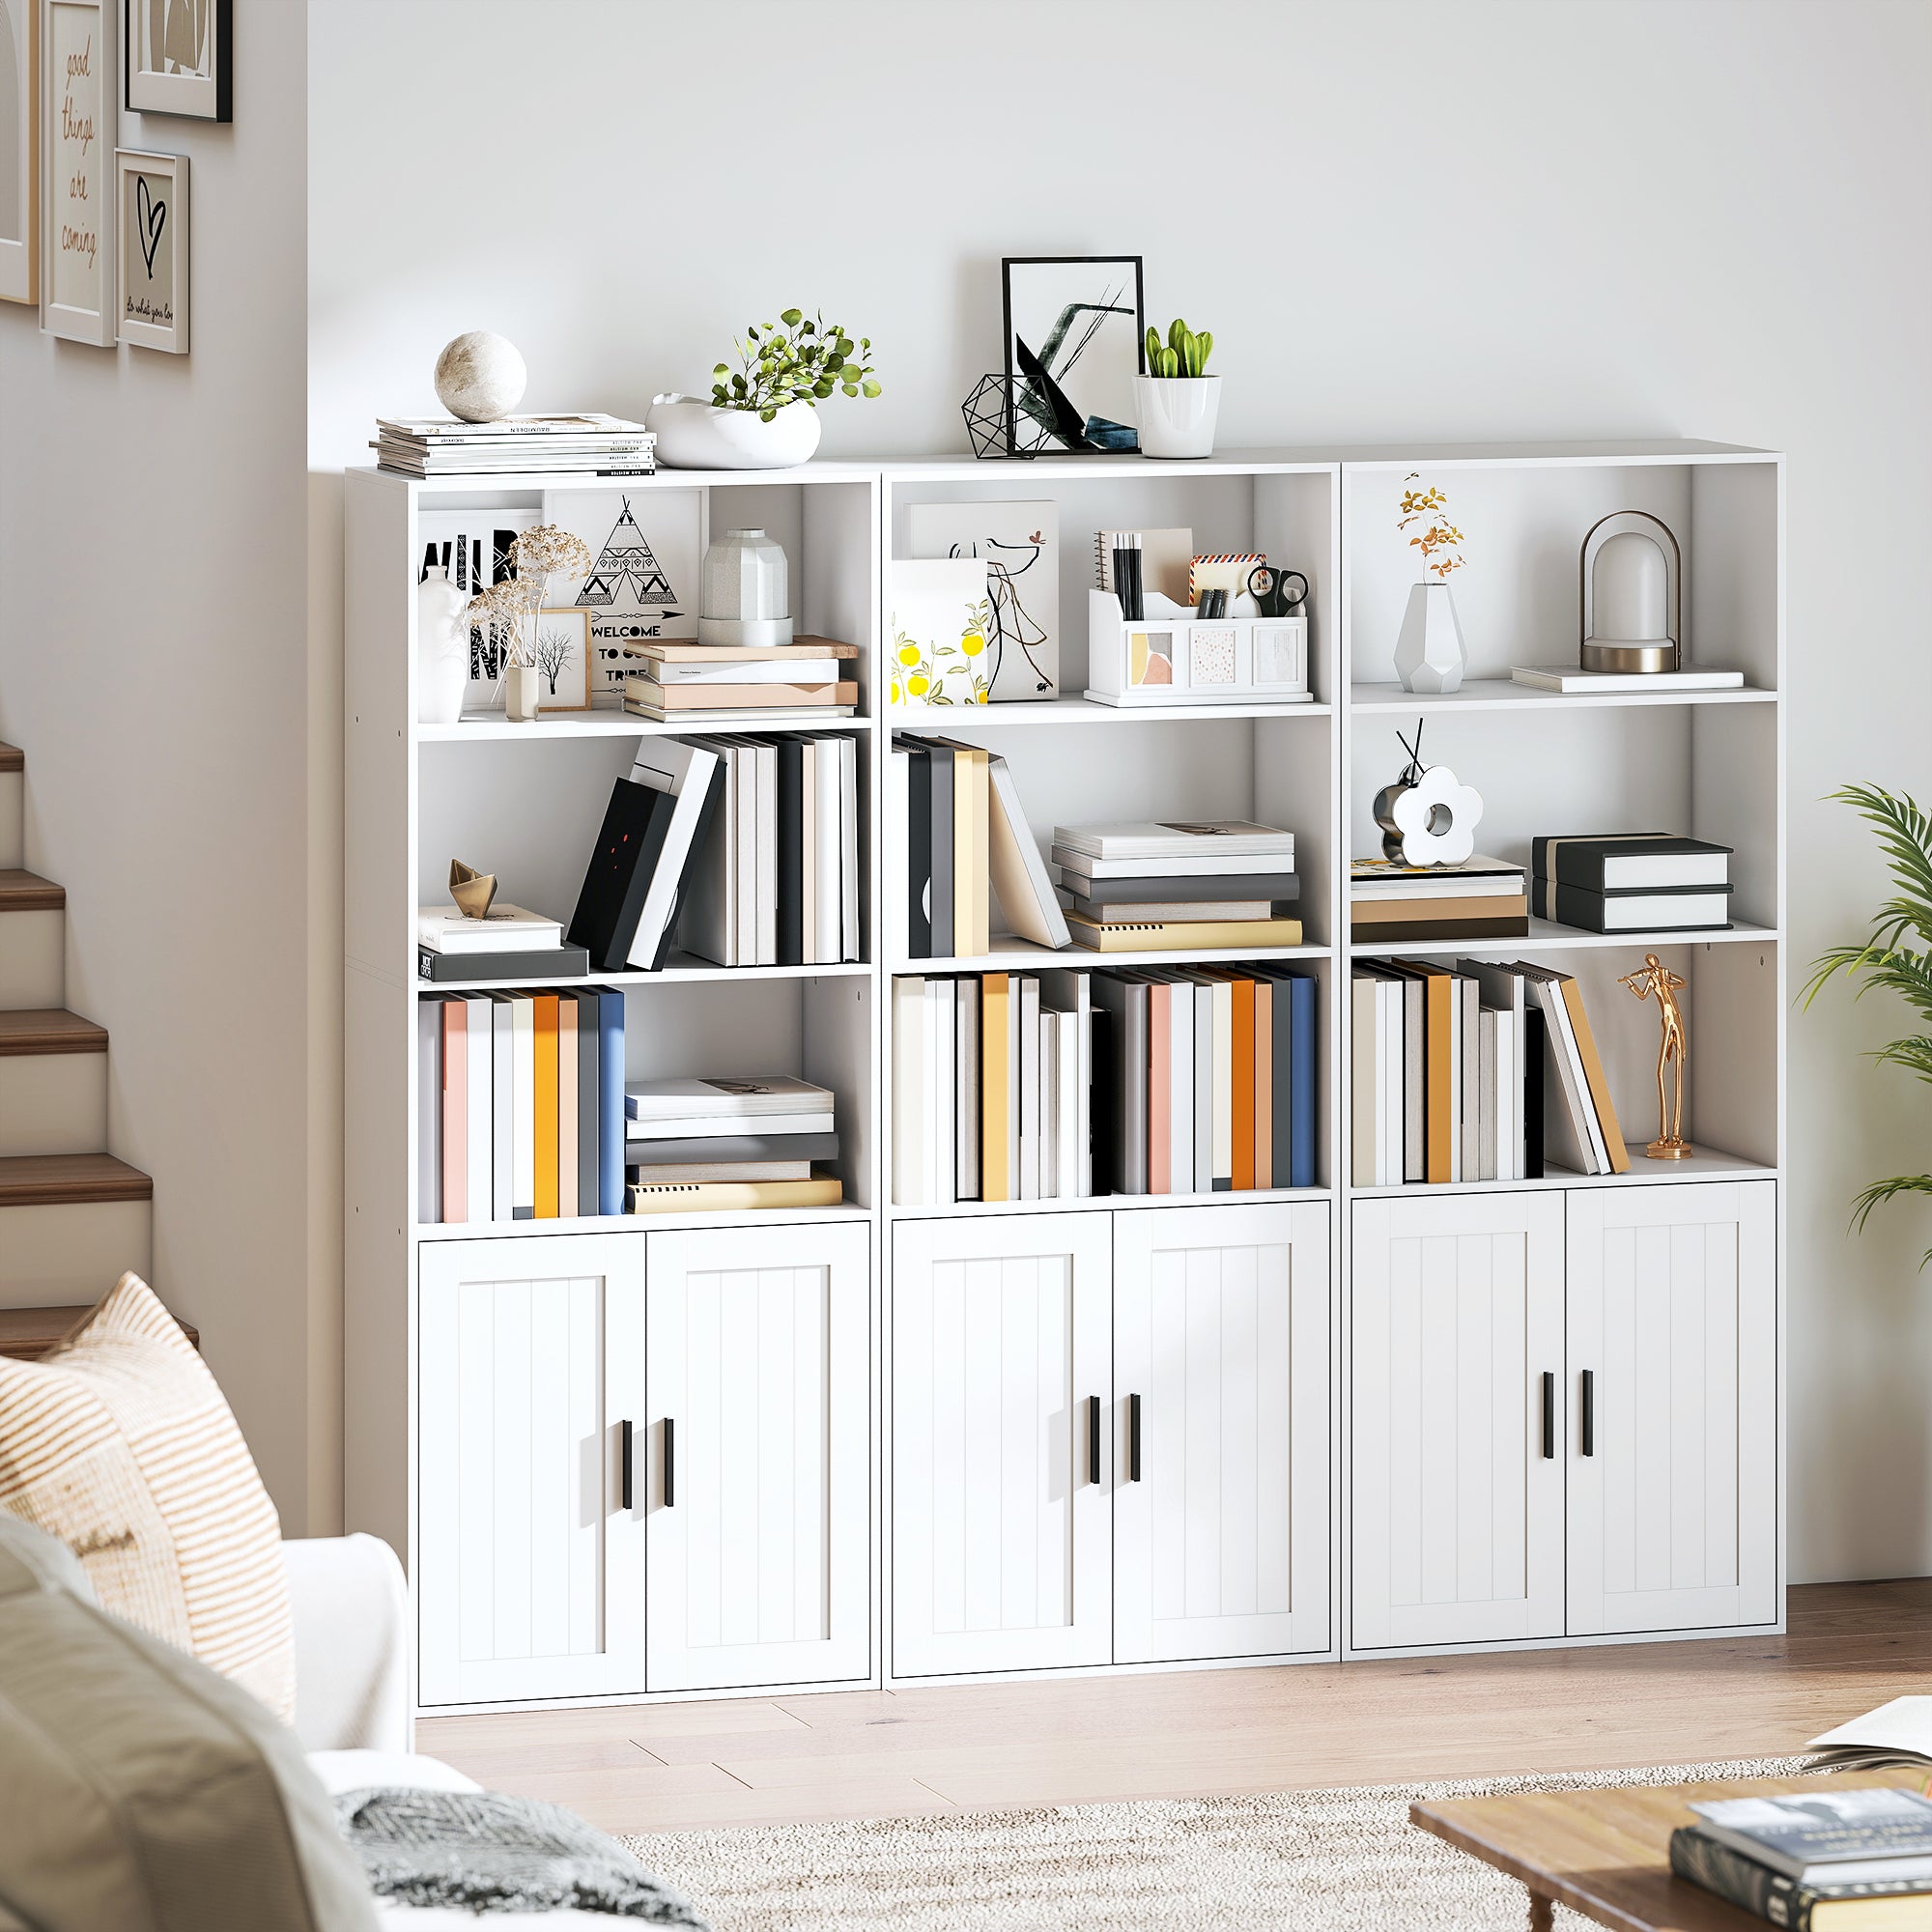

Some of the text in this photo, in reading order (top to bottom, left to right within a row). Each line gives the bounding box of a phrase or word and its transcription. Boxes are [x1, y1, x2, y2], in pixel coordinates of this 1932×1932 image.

[66, 34, 91, 91] good
[62, 95, 95, 156] things
[70, 169, 88, 201] are
[62, 222, 97, 270] coming
[591, 625, 661, 638] WELCOME
[598, 648, 619, 660] TO
